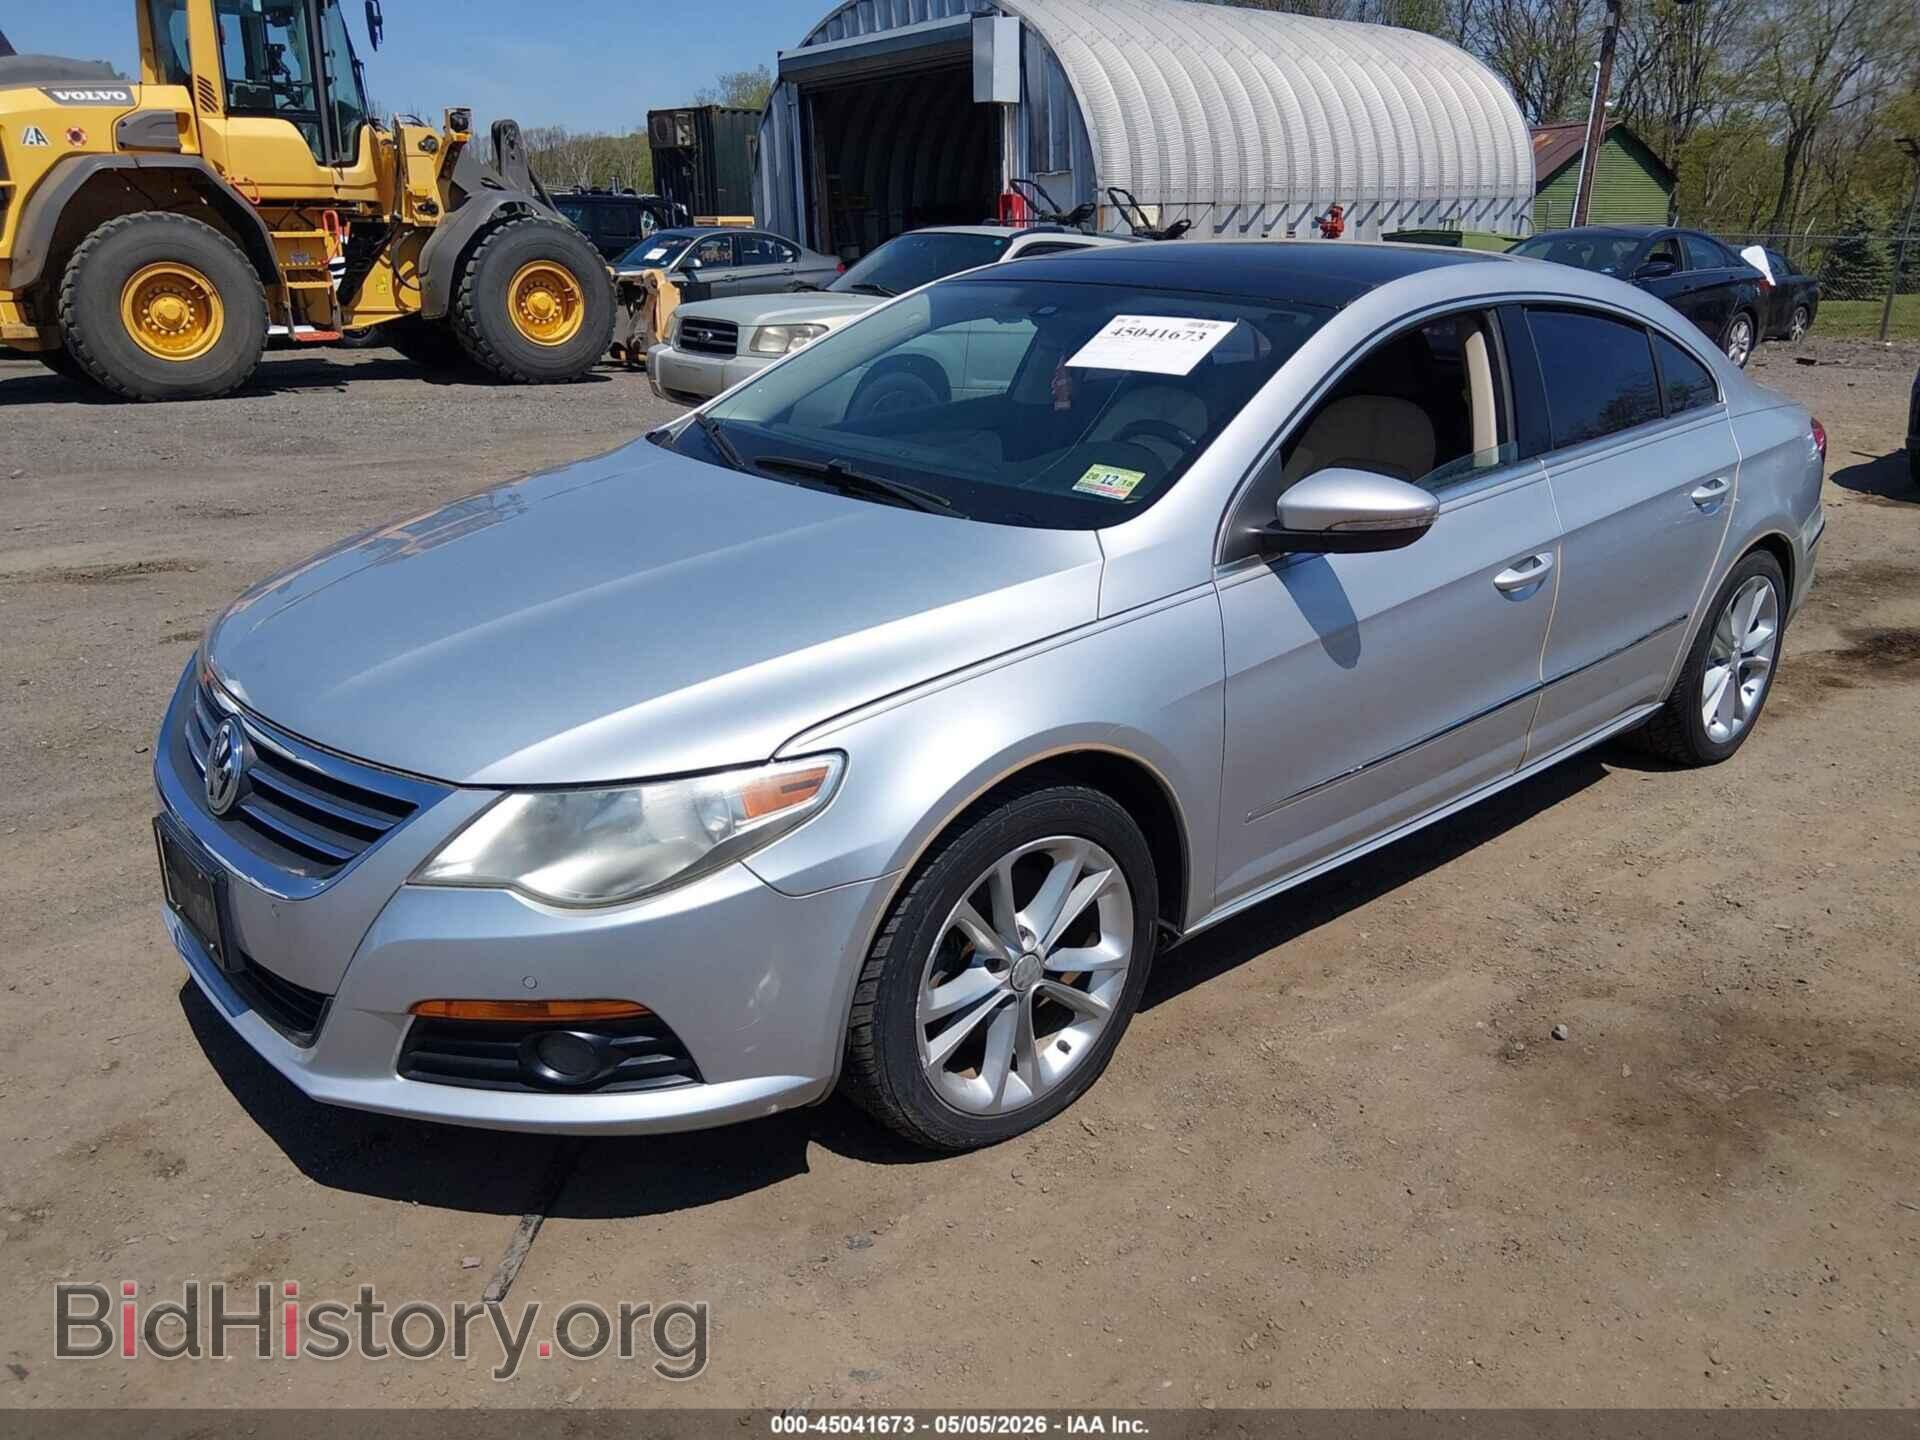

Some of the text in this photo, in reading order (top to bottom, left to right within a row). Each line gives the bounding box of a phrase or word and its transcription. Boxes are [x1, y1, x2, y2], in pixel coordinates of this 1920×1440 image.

[52, 90, 128, 101] VOLVO
[1110, 326, 1207, 343] 45041673
[1101, 474, 1119, 486] 12
